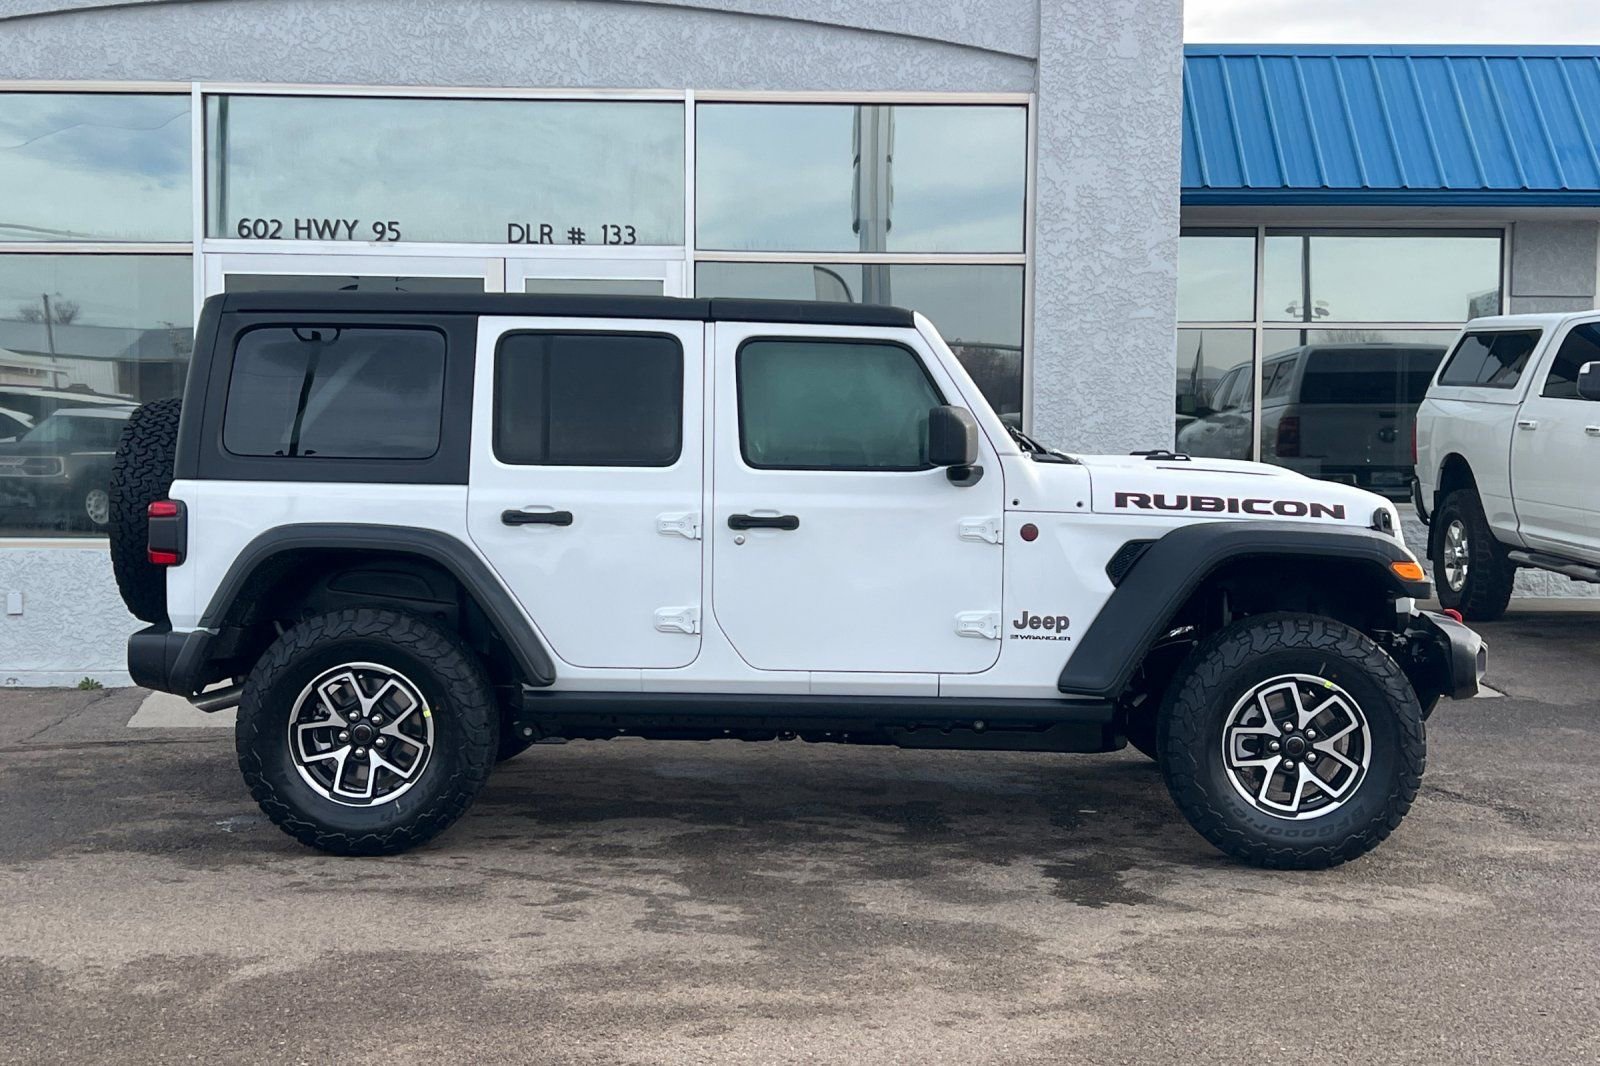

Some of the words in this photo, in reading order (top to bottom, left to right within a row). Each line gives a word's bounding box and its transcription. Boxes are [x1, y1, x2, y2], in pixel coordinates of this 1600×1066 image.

[237, 218, 283, 240] 602
[294, 218, 359, 241] HWY
[372, 221, 401, 242] 95
[507, 223, 554, 245] DLR
[567, 226, 586, 245] #
[601, 224, 637, 246] 133
[1115, 492, 1346, 520] RUBICON
[1013, 610, 1070, 634] Jeep
